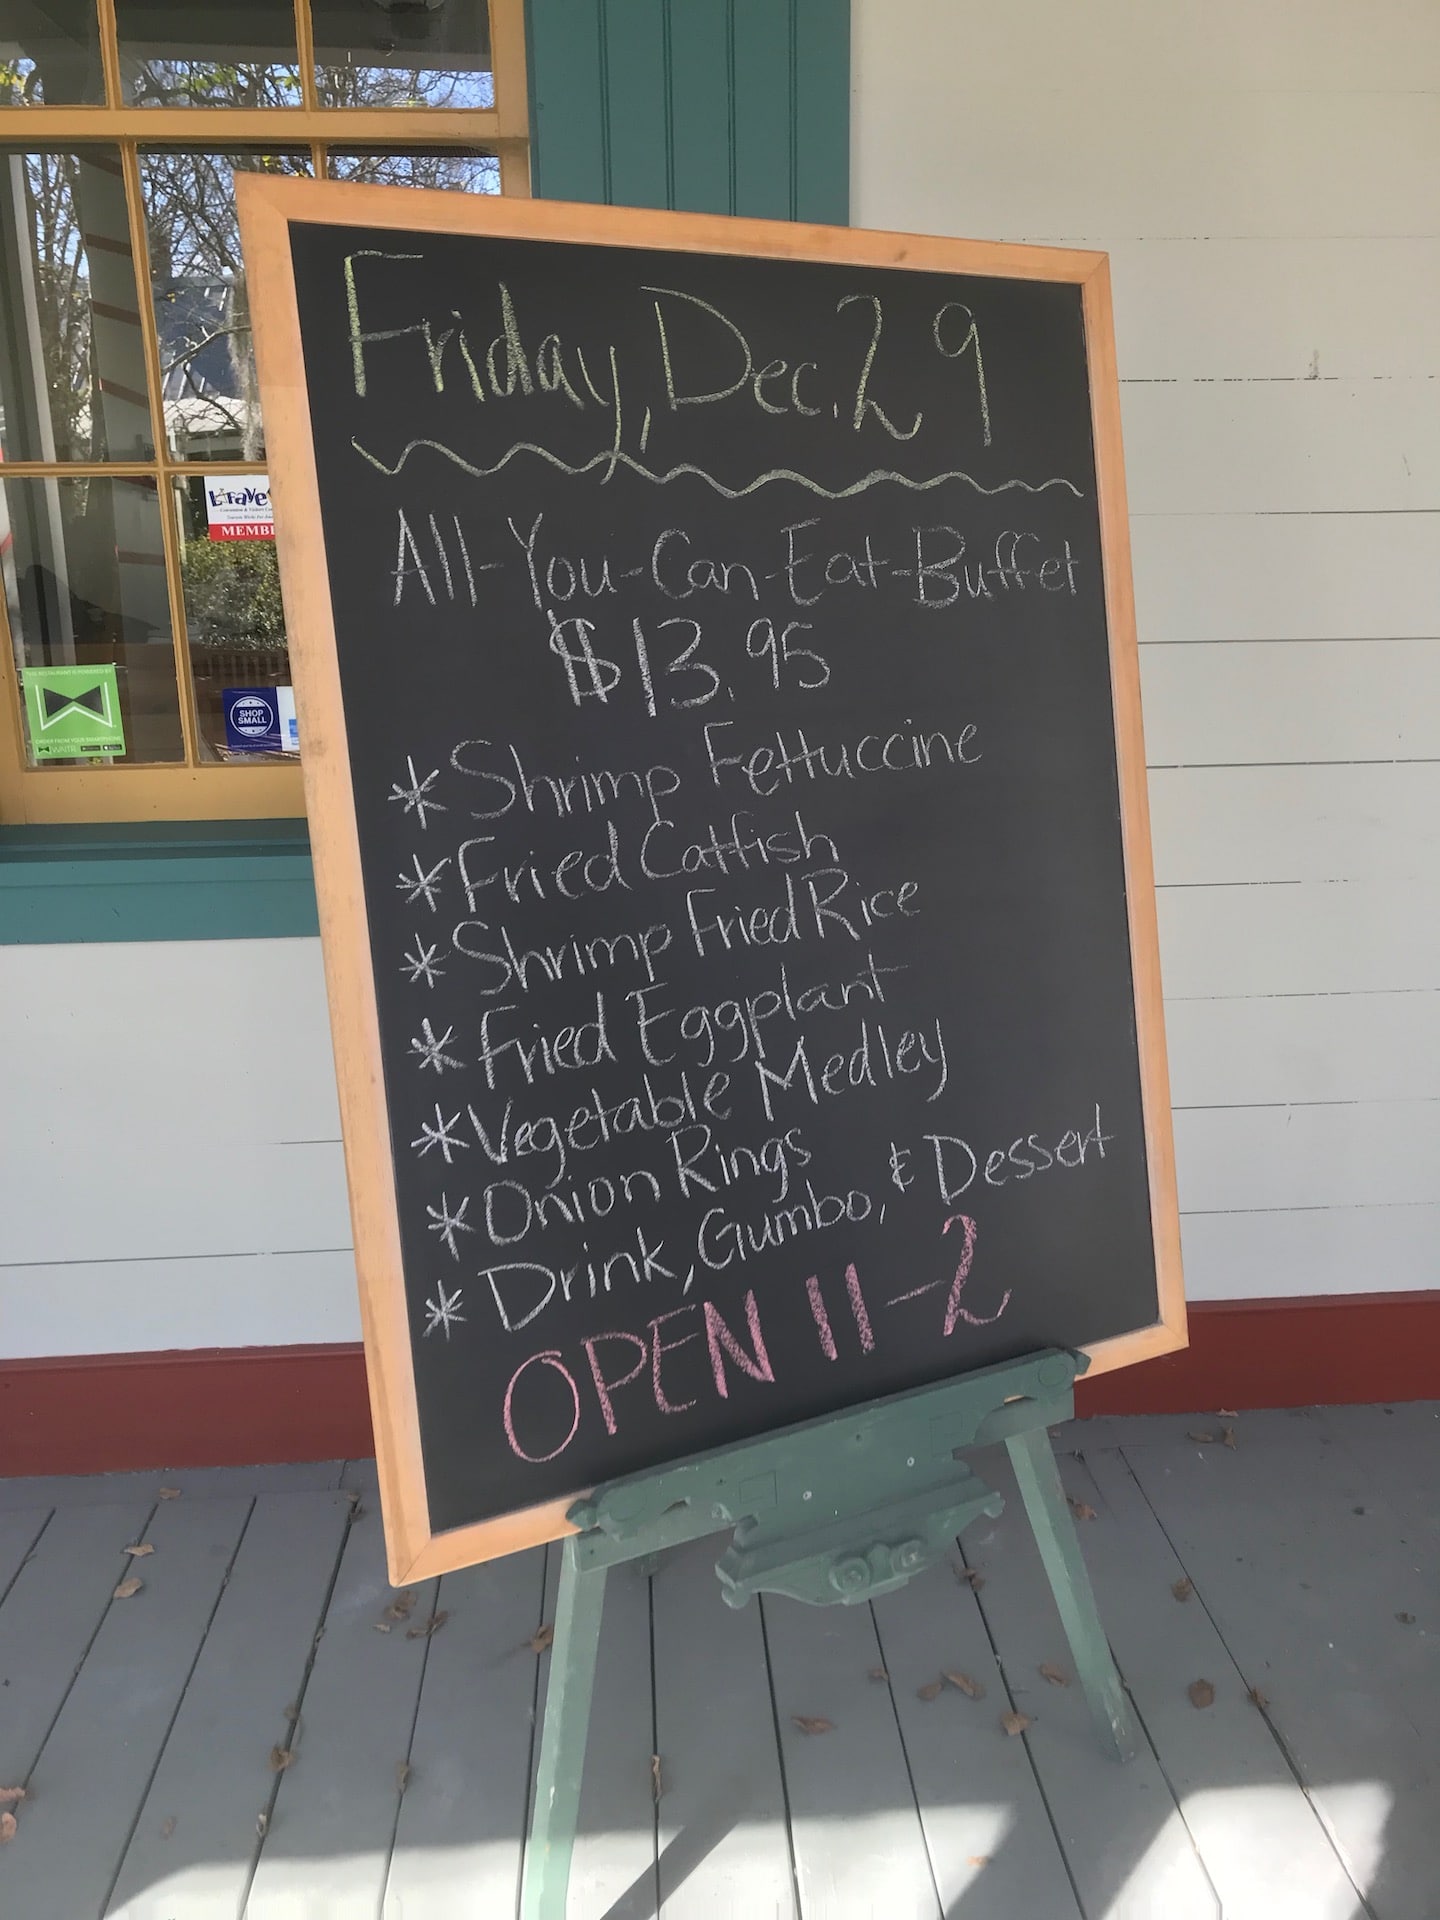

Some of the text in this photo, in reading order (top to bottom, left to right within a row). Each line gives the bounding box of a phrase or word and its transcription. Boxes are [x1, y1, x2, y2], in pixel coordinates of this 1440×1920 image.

[640, 285, 839, 418] Dec.
[836, 294, 992, 446] 29
[238, 717, 267, 725] SMALL
[239, 709, 264, 717] SHOP
[549, 609, 831, 718] $13.95
[449, 719, 983, 821] Shrimp Fettuccine
[457, 810, 840, 913] Fried Catfish
[452, 867, 921, 996] Shrimp Fried Rice
[479, 953, 909, 1090] Fried Eggplant
[468, 1018, 949, 1189] Vegetable Medley
[478, 1226, 695, 1332] Drink,
[697, 1180, 887, 1271] Gumbo,
[923, 1103, 1115, 1205] Dessert
[483, 1123, 812, 1246] Onion Rings
[503, 1289, 776, 1463] OPEN
